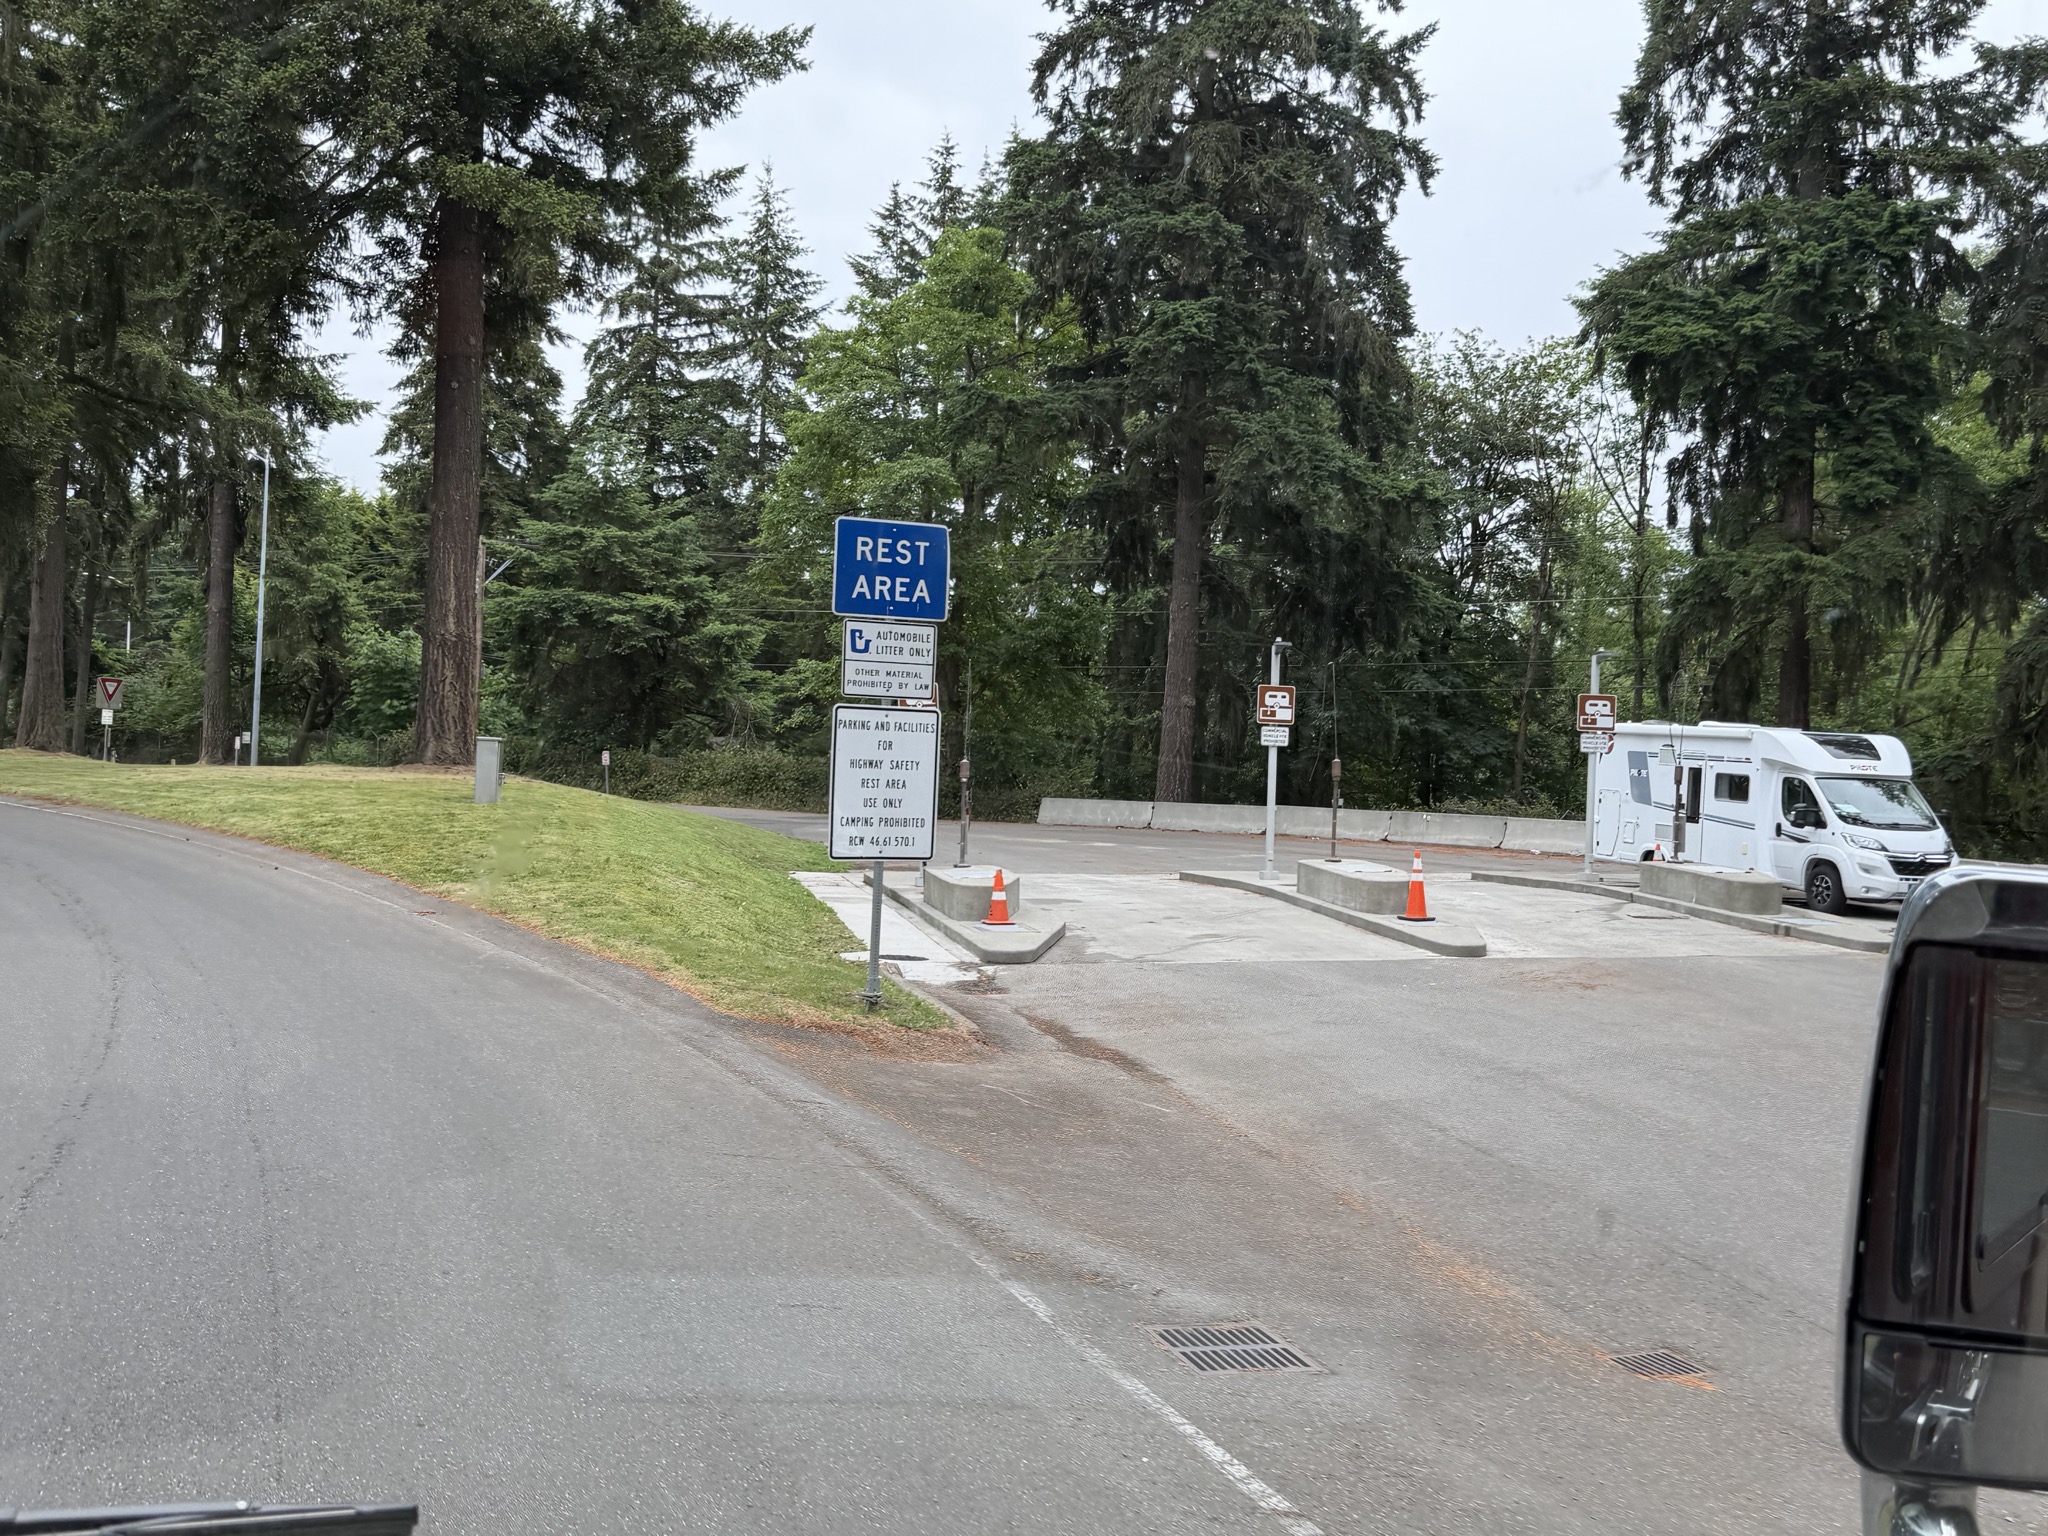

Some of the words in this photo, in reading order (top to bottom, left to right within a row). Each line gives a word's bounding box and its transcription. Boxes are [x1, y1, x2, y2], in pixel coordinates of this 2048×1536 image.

[857, 536, 929, 565] REST
[851, 575, 931, 603] AREA
[876, 631, 932, 644] AUTOMOBILE
[876, 645, 904, 656] LITTER
[909, 647, 931, 658] ONLY
[855, 668, 880, 677] OTHER
[885, 670, 923, 680] MATERIAL
[846, 679, 893, 689] PROHIBITED
[898, 682, 909, 690] BY
[914, 683, 930, 691] LAW
[838, 719, 871, 731] PARKING
[874, 721, 890, 732] AND
[894, 722, 935, 734] FACILITIES
[877, 740, 893, 751] FOR
[849, 758, 883, 770] HIGHWAY
[889, 760, 920, 771] SAFETY
[861, 778, 880, 789] REST
[885, 779, 907, 790] AREA
[863, 798, 878, 808] USE
[883, 798, 903, 809] ONLY
[840, 816, 874, 828] CAMPING
[878, 817, 926, 829] PROHIBITED
[848, 836, 865, 847] RCW
